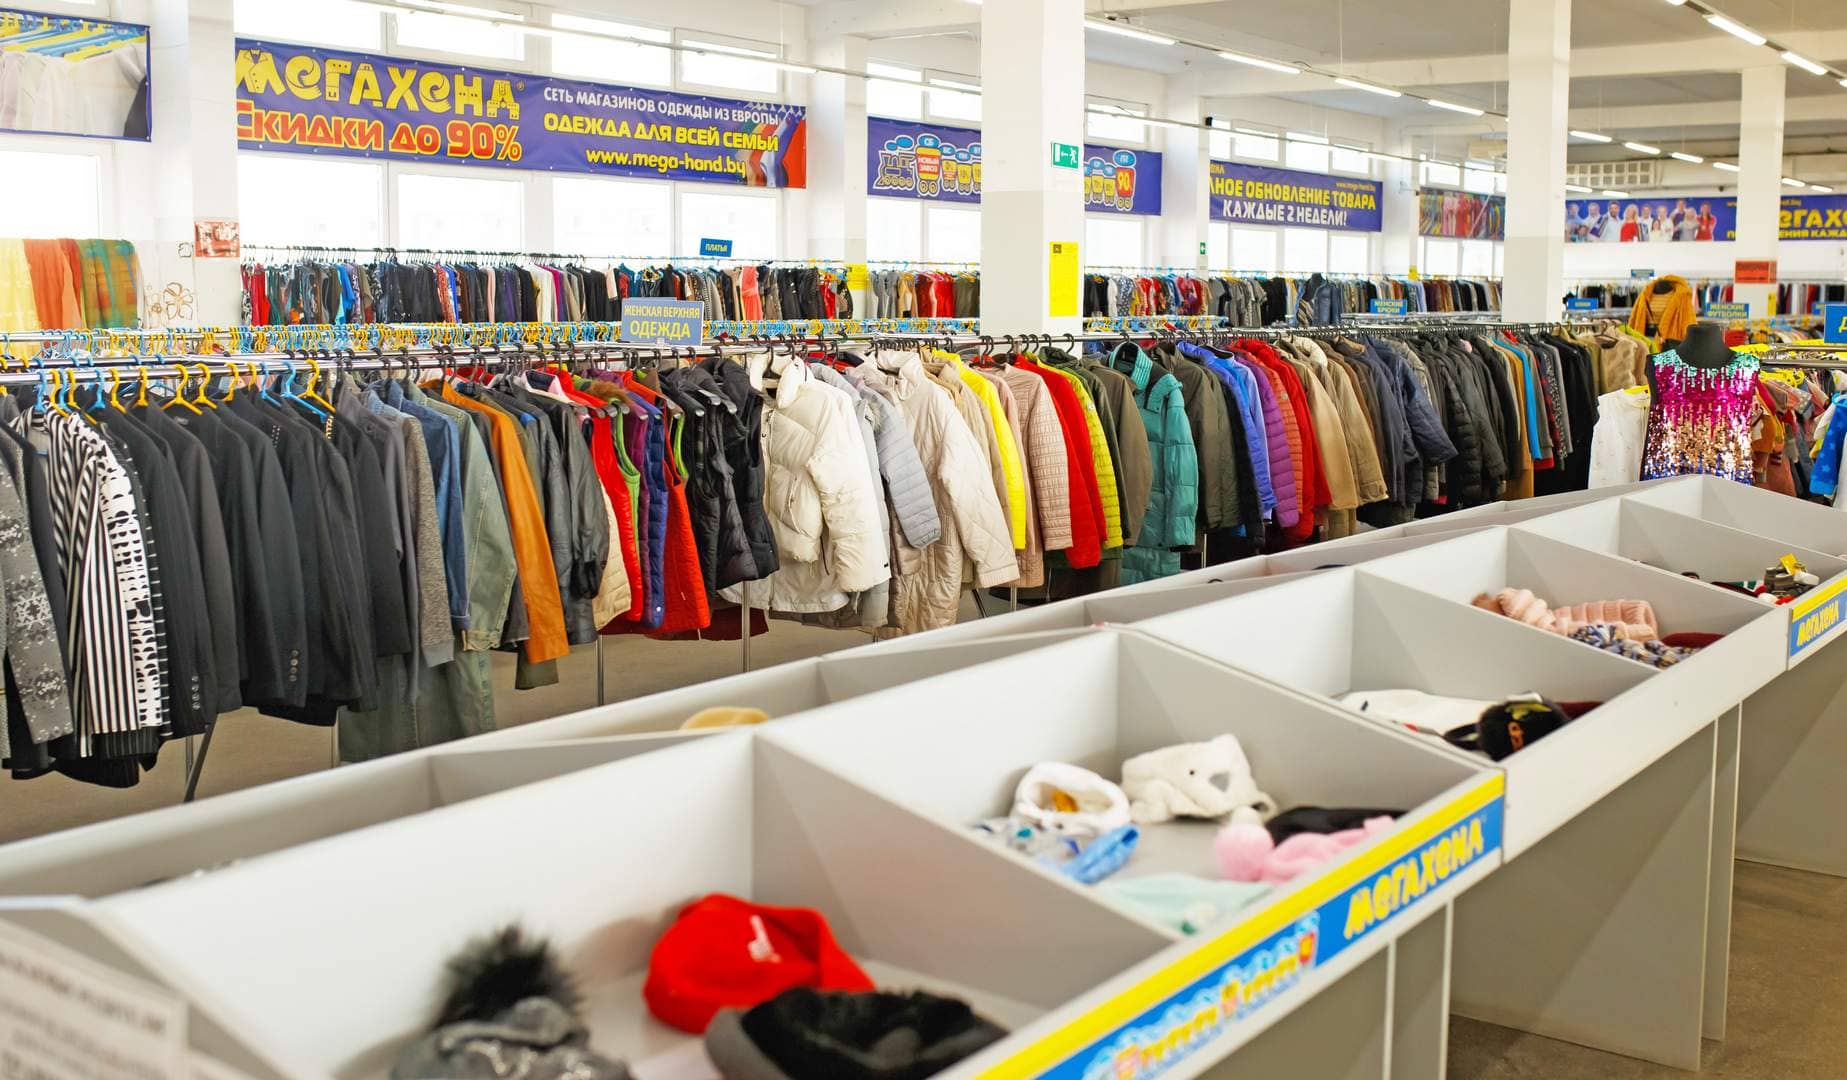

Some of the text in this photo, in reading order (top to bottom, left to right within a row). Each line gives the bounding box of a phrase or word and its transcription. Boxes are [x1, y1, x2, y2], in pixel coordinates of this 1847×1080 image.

[544, 86, 779, 126] СЕТЬ МАГАЗИНОВ ОДЕЖДЫ ИЗ ЕВРОПЫ
[446, 120, 523, 161] 90%
[543, 112, 780, 152] ОДЕЖДА ДЛЯ ВСЕЙ СЕМЬИ
[586, 148, 747, 179] www.mega-hand.by
[1245, 180, 1330, 206] ОБНОВЛЕНИЕ
[1332, 190, 1377, 210] ТОВАРА
[1223, 199, 1348, 227] КАЖДЫЕ 2 НЕДЕЛИ!
[623, 304, 700, 319] ЖЕНСКАЯ ВЕРХНЯЯ
[629, 320, 691, 340] ОДЕЖДА
